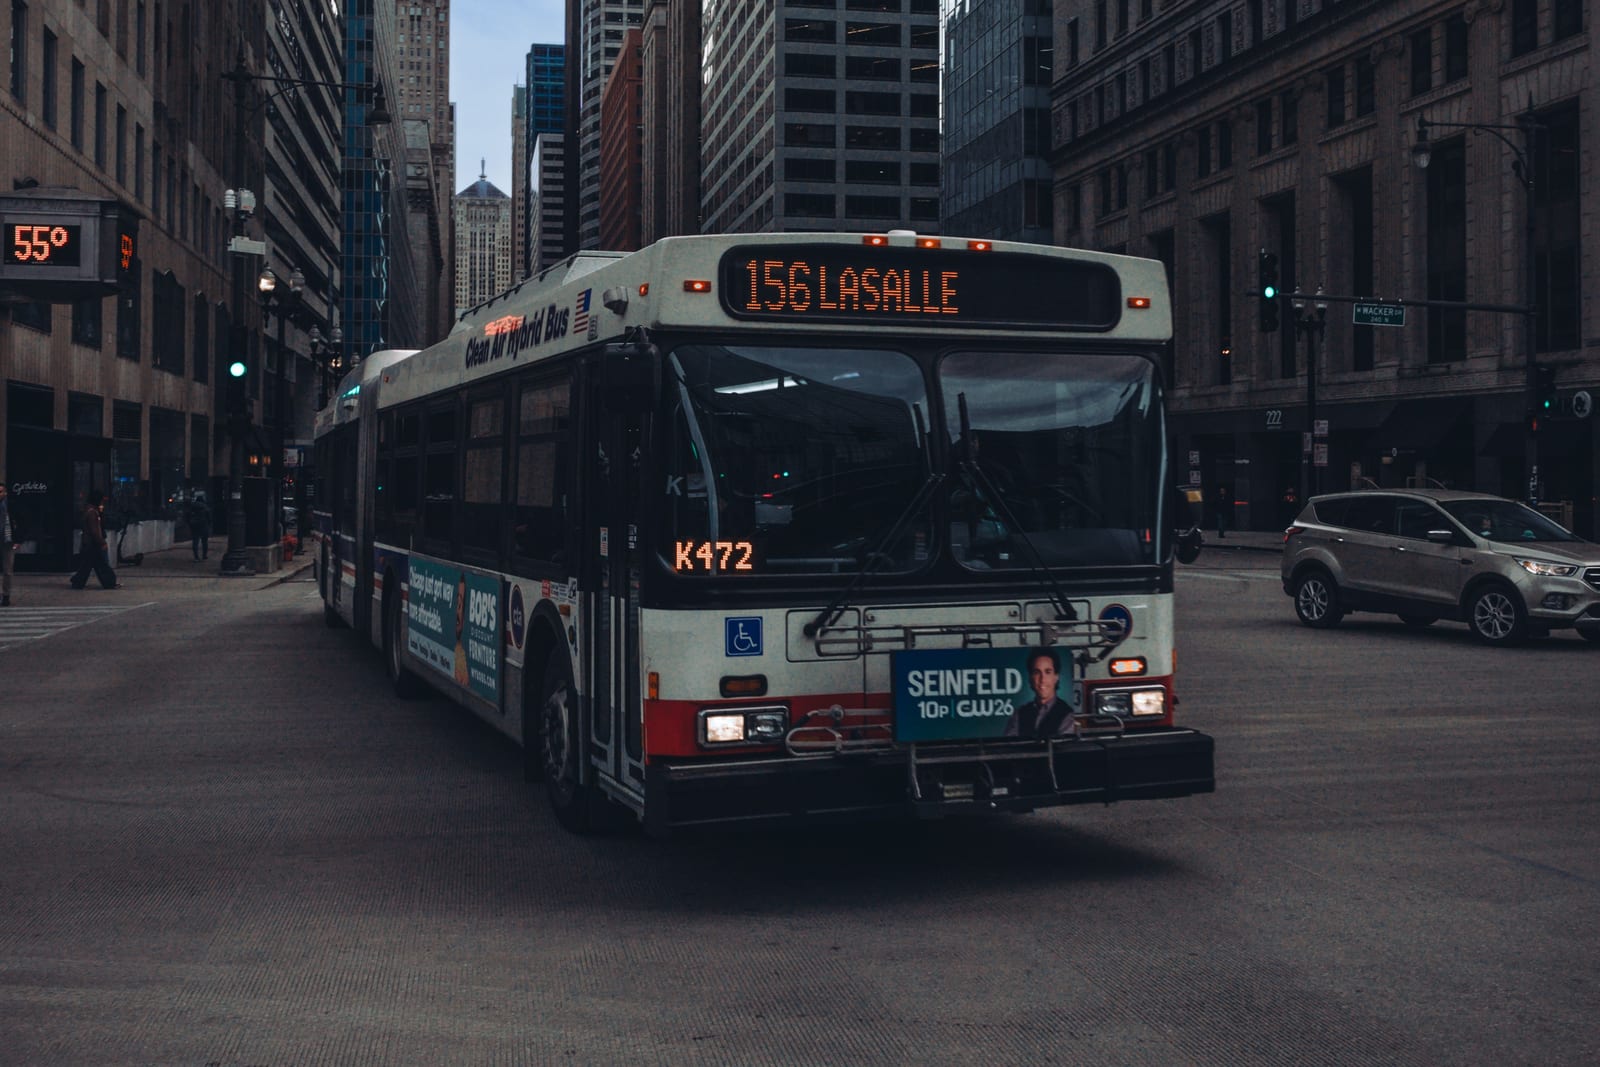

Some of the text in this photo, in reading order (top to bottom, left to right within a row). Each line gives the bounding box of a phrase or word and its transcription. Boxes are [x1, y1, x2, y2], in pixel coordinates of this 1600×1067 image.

[746, 259, 959, 314] 156 LASALLE
[1362, 306, 1394, 316] WACKER
[466, 338, 490, 369] Clean
[490, 329, 507, 361] Air
[507, 307, 545, 361] Hybrid
[545, 303, 570, 342] Bus
[1265, 410, 1282, 425] 222
[675, 541, 753, 570] K472
[443, 582, 454, 609] way
[469, 588, 497, 632] BOB'S
[469, 638, 496, 670] FURNITURE
[907, 668, 1023, 697] SEINFELD
